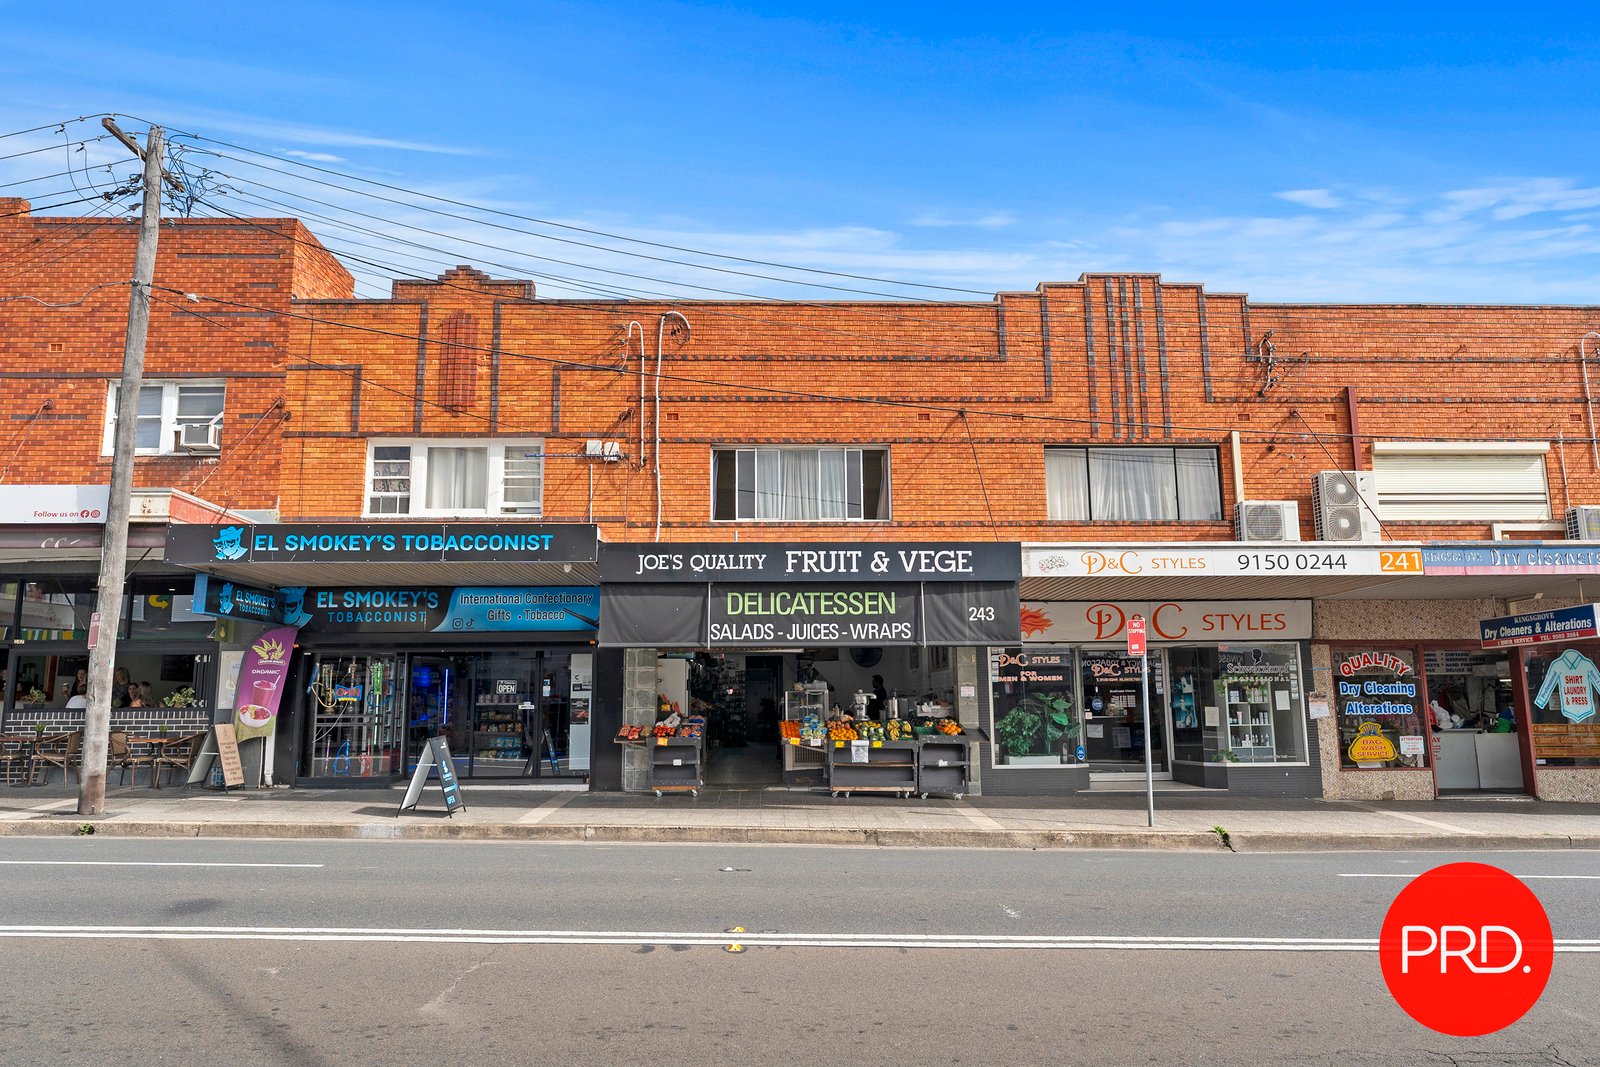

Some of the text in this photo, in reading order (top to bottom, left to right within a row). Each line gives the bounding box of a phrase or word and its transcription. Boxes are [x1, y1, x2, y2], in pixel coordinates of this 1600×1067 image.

[34, 510, 55, 518] Follow
[254, 534, 554, 551] EL SMOKEY'S TOBACCONIST
[636, 551, 973, 574] JOE'S QUALITY FRUIT & VEGE
[1151, 558, 1206, 569] STYLES
[1238, 554, 1348, 570] 9150 0244
[1381, 552, 1420, 570] 241
[1490, 549, 1520, 569] Dry
[236, 590, 276, 608] EL SMOKEY'S
[317, 591, 438, 608] EL SMOKEY'S
[460, 592, 593, 606] International Confectionary
[727, 592, 895, 615] DELICATESSEN
[239, 603, 271, 616] TOBACCONIST
[328, 612, 426, 622] TOBACCONIST
[487, 610, 565, 620] Gifts Tobacco
[968, 607, 994, 621] 243
[1514, 612, 1554, 623] KINGSGROVE
[1202, 613, 1286, 631] STYLES
[1484, 618, 1592, 640] Dry Cleaners & Alterations
[710, 624, 774, 640] SALADS
[786, 624, 838, 640] JUICES
[850, 623, 911, 639] WRAPS
[1340, 652, 1412, 676] QUALITY
[1565, 676, 1583, 684] SHIRT
[1340, 681, 1416, 697] Dry Cleaning
[1563, 686, 1586, 695] LAUNDRY
[1345, 701, 1413, 715] Alterations
[1572, 696, 1588, 705] PRESS
